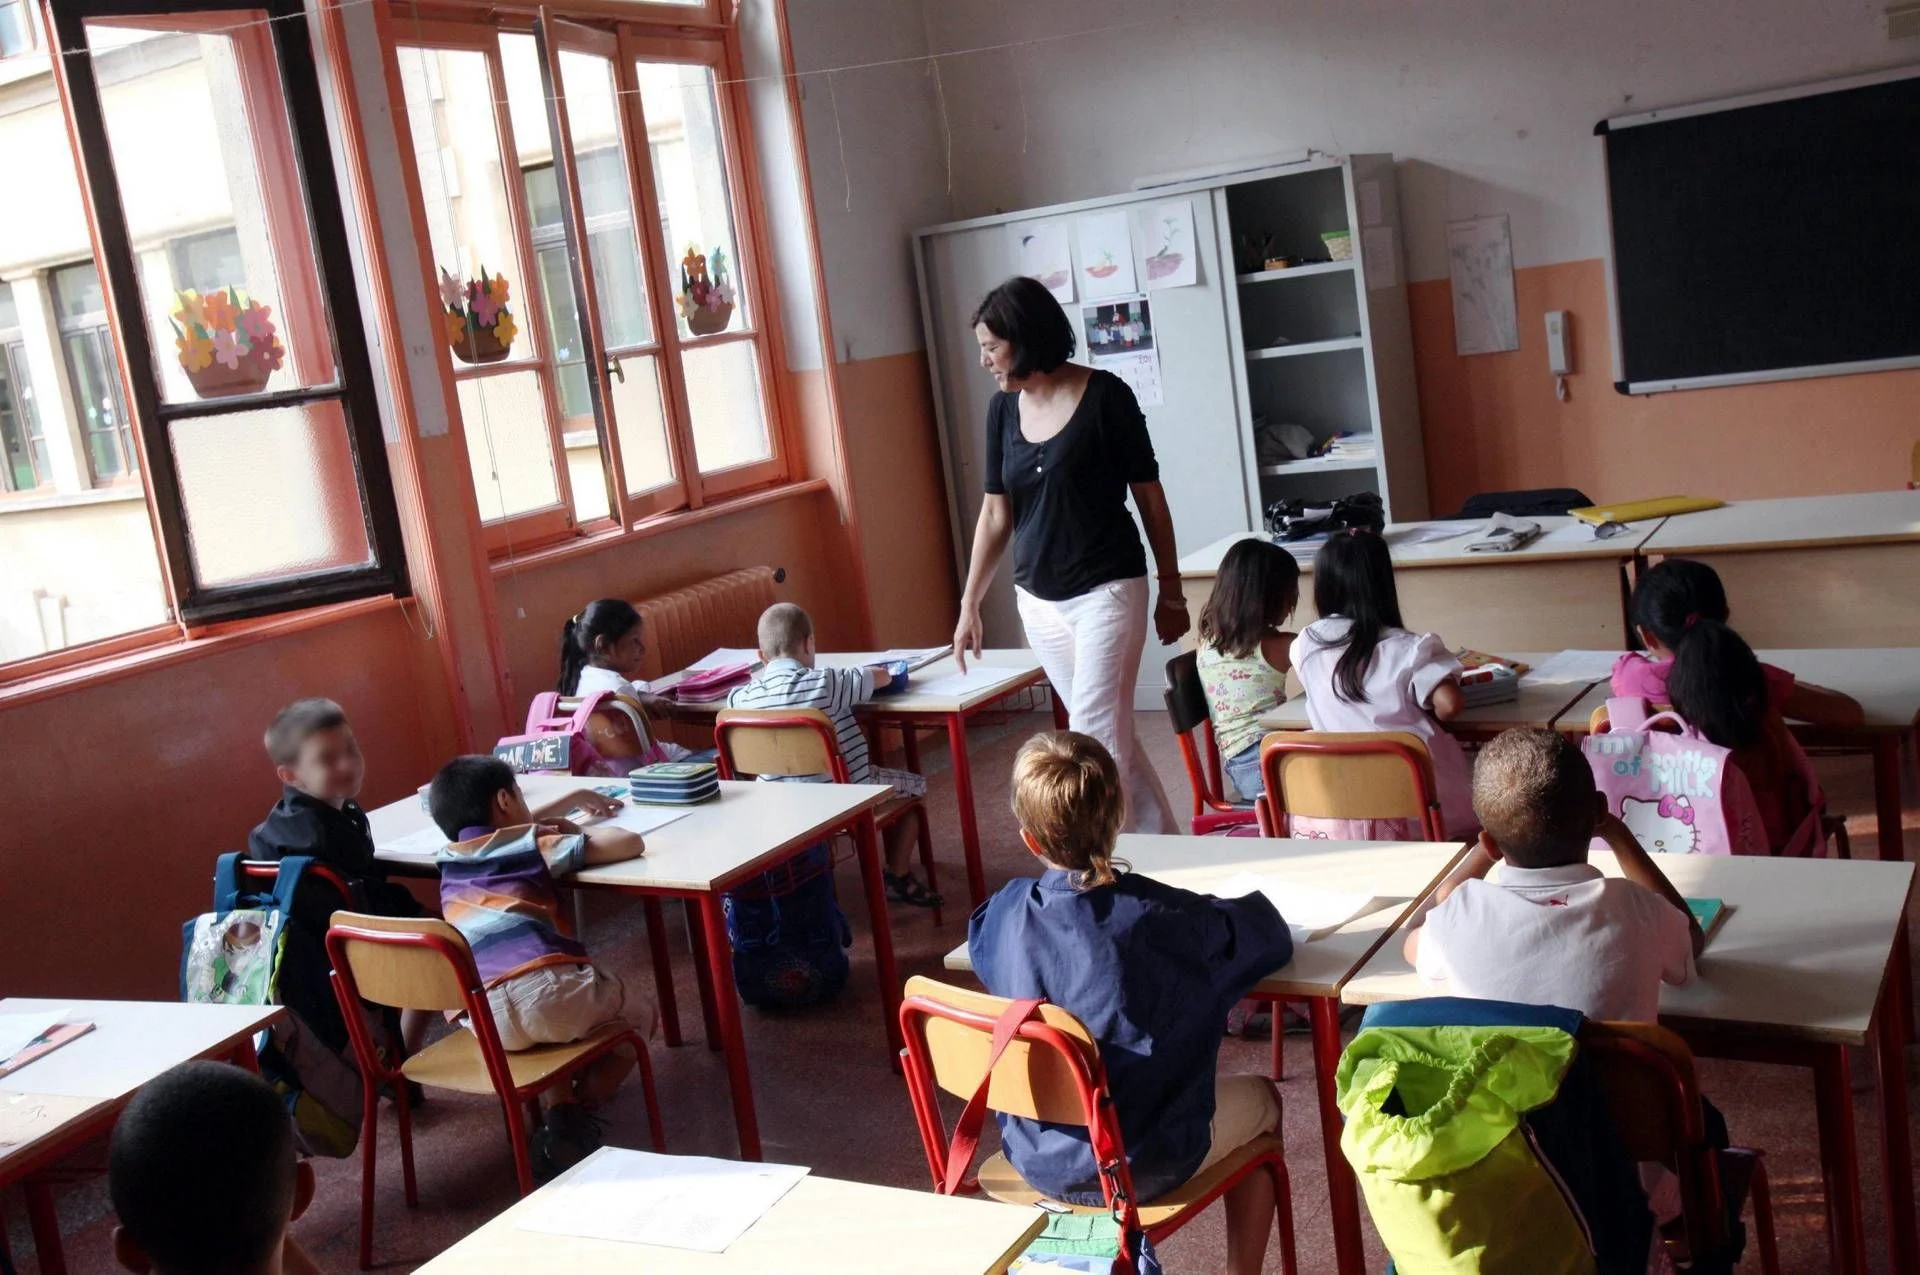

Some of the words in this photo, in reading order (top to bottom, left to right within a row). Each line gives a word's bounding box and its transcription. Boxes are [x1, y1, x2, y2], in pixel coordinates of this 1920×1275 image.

[1590, 735, 1644, 757] my
[1612, 755, 1642, 777] of
[1650, 766, 1714, 798] MILK
